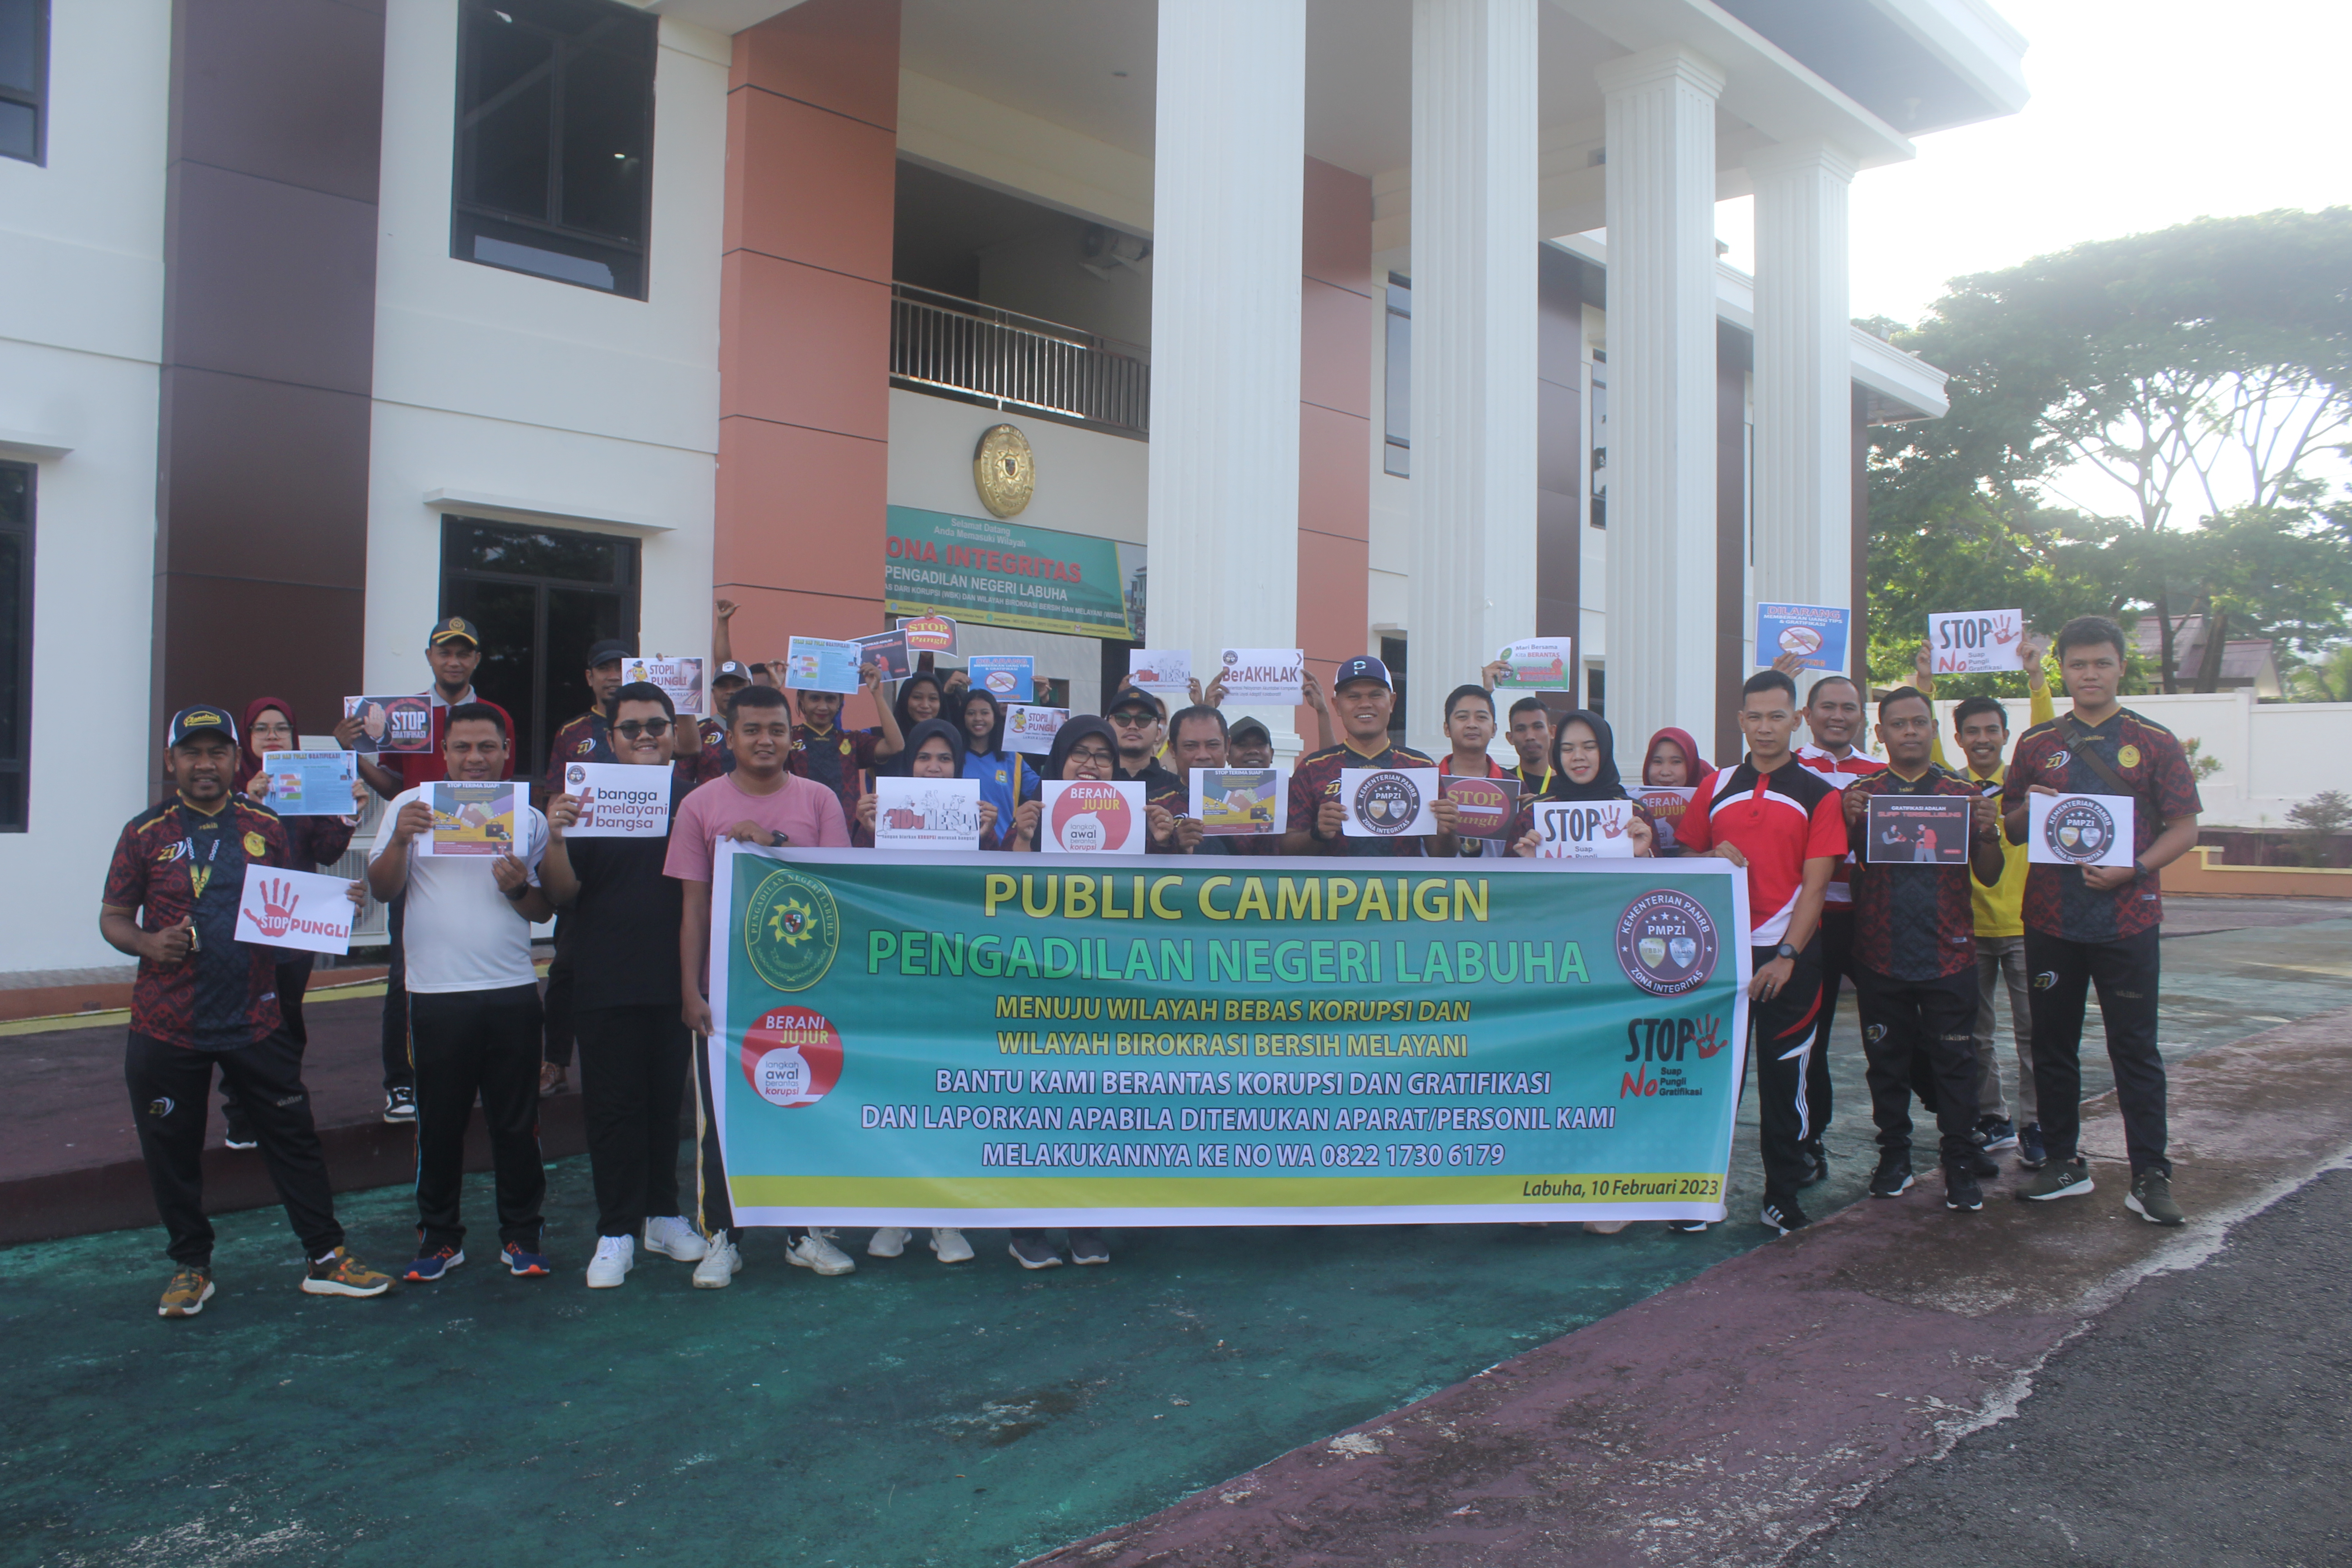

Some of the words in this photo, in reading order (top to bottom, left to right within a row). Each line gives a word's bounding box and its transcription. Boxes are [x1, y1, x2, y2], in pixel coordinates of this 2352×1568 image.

[951, 519, 982, 530] Selamat
[984, 523, 1011, 537] Datang
[934, 526, 954, 536] Anda
[957, 529, 995, 543] Memasuki
[997, 536, 1026, 548] Wilayah
[886, 535, 938, 564] ONA
[946, 544, 1082, 583] INTEGRITAS
[971, 577, 1016, 594] NEGERI
[1020, 583, 1068, 601] LABUHA
[911, 587, 941, 597] KORUPSI
[962, 593, 976, 601] DAN
[977, 595, 1004, 605] WILAYAH
[1005, 598, 1038, 609] BIROKRASI
[1039, 603, 1060, 612] BERSIH
[1075, 608, 1102, 617] MELAYANI
[1767, 606, 1840, 618] DILARANG
[909, 623, 948, 632] STOP
[1940, 618, 1992, 649] STOP
[911, 636, 947, 645] Pungli
[1939, 649, 1966, 672] No
[651, 676, 687, 686] PUNGLI
[1222, 666, 1298, 682] BerAKHLAK
[392, 711, 426, 730] STOP
[1028, 723, 1056, 732] PUNGLI
[1070, 788, 1117, 799] BERANI
[1358, 774, 1401, 799] KEMENTERIAN
[1401, 778, 1417, 798] PANRB
[598, 788, 657, 804] bangga
[1447, 790, 1503, 806] STOP
[1642, 796, 1683, 807] BERANI
[597, 803, 668, 818] melayani
[1082, 799, 1120, 810] JUJUR
[1653, 805, 1686, 816] JUJUR
[2048, 800, 2094, 824] KEMENTERIAN
[2094, 805, 2112, 826] PANRB
[596, 816, 653, 831] bangsa
[1362, 818, 1376, 831] ZONA
[1376, 819, 1410, 834] INTEGRITAS
[1458, 815, 1499, 828] ungli
[1544, 808, 1601, 842] STOP
[1071, 830, 1096, 838] awal
[2052, 845, 2067, 860] ZONA
[985, 873, 1183, 920] PUBLIC
[1198, 875, 1489, 922] CAMPAIGN
[751, 876, 784, 934] PENGADILAN
[819, 896, 834, 936] LABUHA
[1621, 895, 1682, 934] KEMENTERIAN
[1683, 902, 1710, 933] PANRB
[260, 916, 289, 929] STOP
[290, 918, 349, 938] PUNGLI
[1647, 926, 1686, 935] PMPZI
[867, 929, 1193, 982] PENGADILAN
[1209, 939, 1381, 983] NEGERI
[1395, 940, 1590, 984] LABUHA
[1631, 967, 1652, 989] ZONA
[1653, 970, 1703, 993] INTEGRITAS
[995, 995, 1101, 1020] MENUJU
[1106, 998, 1218, 1021] WILAYAH
[1225, 999, 1303, 1022] BEBAS
[1308, 1000, 1411, 1022] KORUPSI
[1417, 1001, 1471, 1022] DAN
[765, 1015, 825, 1029] BERANI
[780, 1030, 829, 1044] JUJUR
[996, 1031, 1109, 1056] WILAYAH
[1116, 1033, 1248, 1057] BIROKRASI
[1254, 1034, 1340, 1057] BERSIH
[1346, 1034, 1468, 1058] MELAYANI
[1625, 1018, 1695, 1062] STOP
[766, 1061, 799, 1069] langkah
[1661, 1067, 1682, 1076] Suap
[766, 1068, 799, 1079] awal
[1620, 1062, 1658, 1099] No
[936, 1069, 1024, 1093] BANTU
[1030, 1070, 1096, 1094] KAMI
[1102, 1071, 1231, 1095] BERANTAS
[1238, 1072, 1343, 1095] KORUPSI
[1349, 1072, 1401, 1095] DAN
[1407, 1071, 1551, 1095] GRATIFIKASI
[1660, 1077, 1686, 1087] Pungli
[765, 1088, 799, 1097] korupsi
[1659, 1088, 1703, 1096] Gratifikasi
[862, 1105, 916, 1129] DAN
[924, 1106, 1062, 1130] LAPORKAN
[1067, 1107, 1175, 1131] APABILA
[1181, 1108, 1329, 1131] DITEMUKAN
[1334, 1107, 1551, 1132] APARAT/PERSONIL
[1556, 1107, 1616, 1130] KAMI
[982, 1143, 1192, 1167] MELAKUKANNYA
[1197, 1144, 1228, 1167] KE
[1234, 1144, 1271, 1167] NO
[1276, 1144, 1315, 1167] WA
[1321, 1144, 1379, 1167] 0822
[1386, 1144, 1443, 1166] 1730
[1447, 1143, 1505, 1166] 6179
[1523, 1181, 1586, 1199] Labuha,
[1592, 1181, 1609, 1196] 10
[1613, 1179, 1676, 1196] Februari
[1679, 1180, 1719, 1196] 2023
